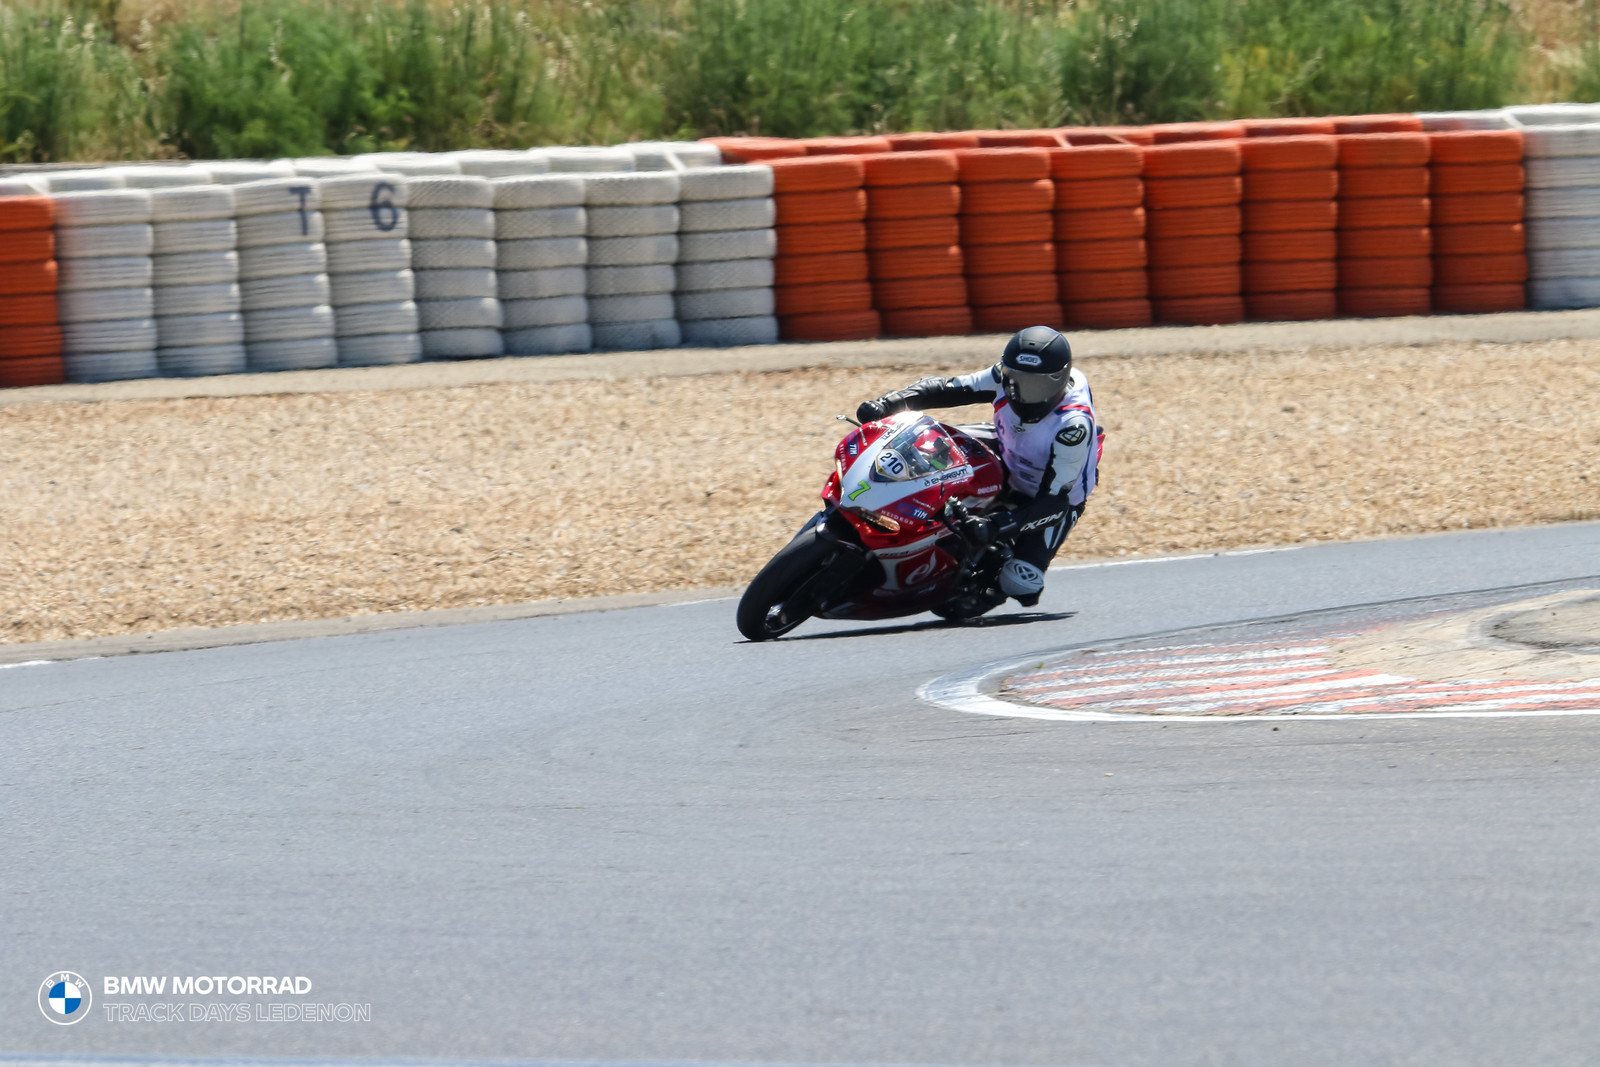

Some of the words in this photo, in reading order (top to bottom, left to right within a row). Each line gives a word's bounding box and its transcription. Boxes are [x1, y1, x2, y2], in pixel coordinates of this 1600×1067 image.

[288, 185, 312, 236] T
[369, 181, 399, 232] 6
[880, 452, 904, 475] 210
[848, 480, 871, 501] 7
[912, 509, 928, 519] TIM
